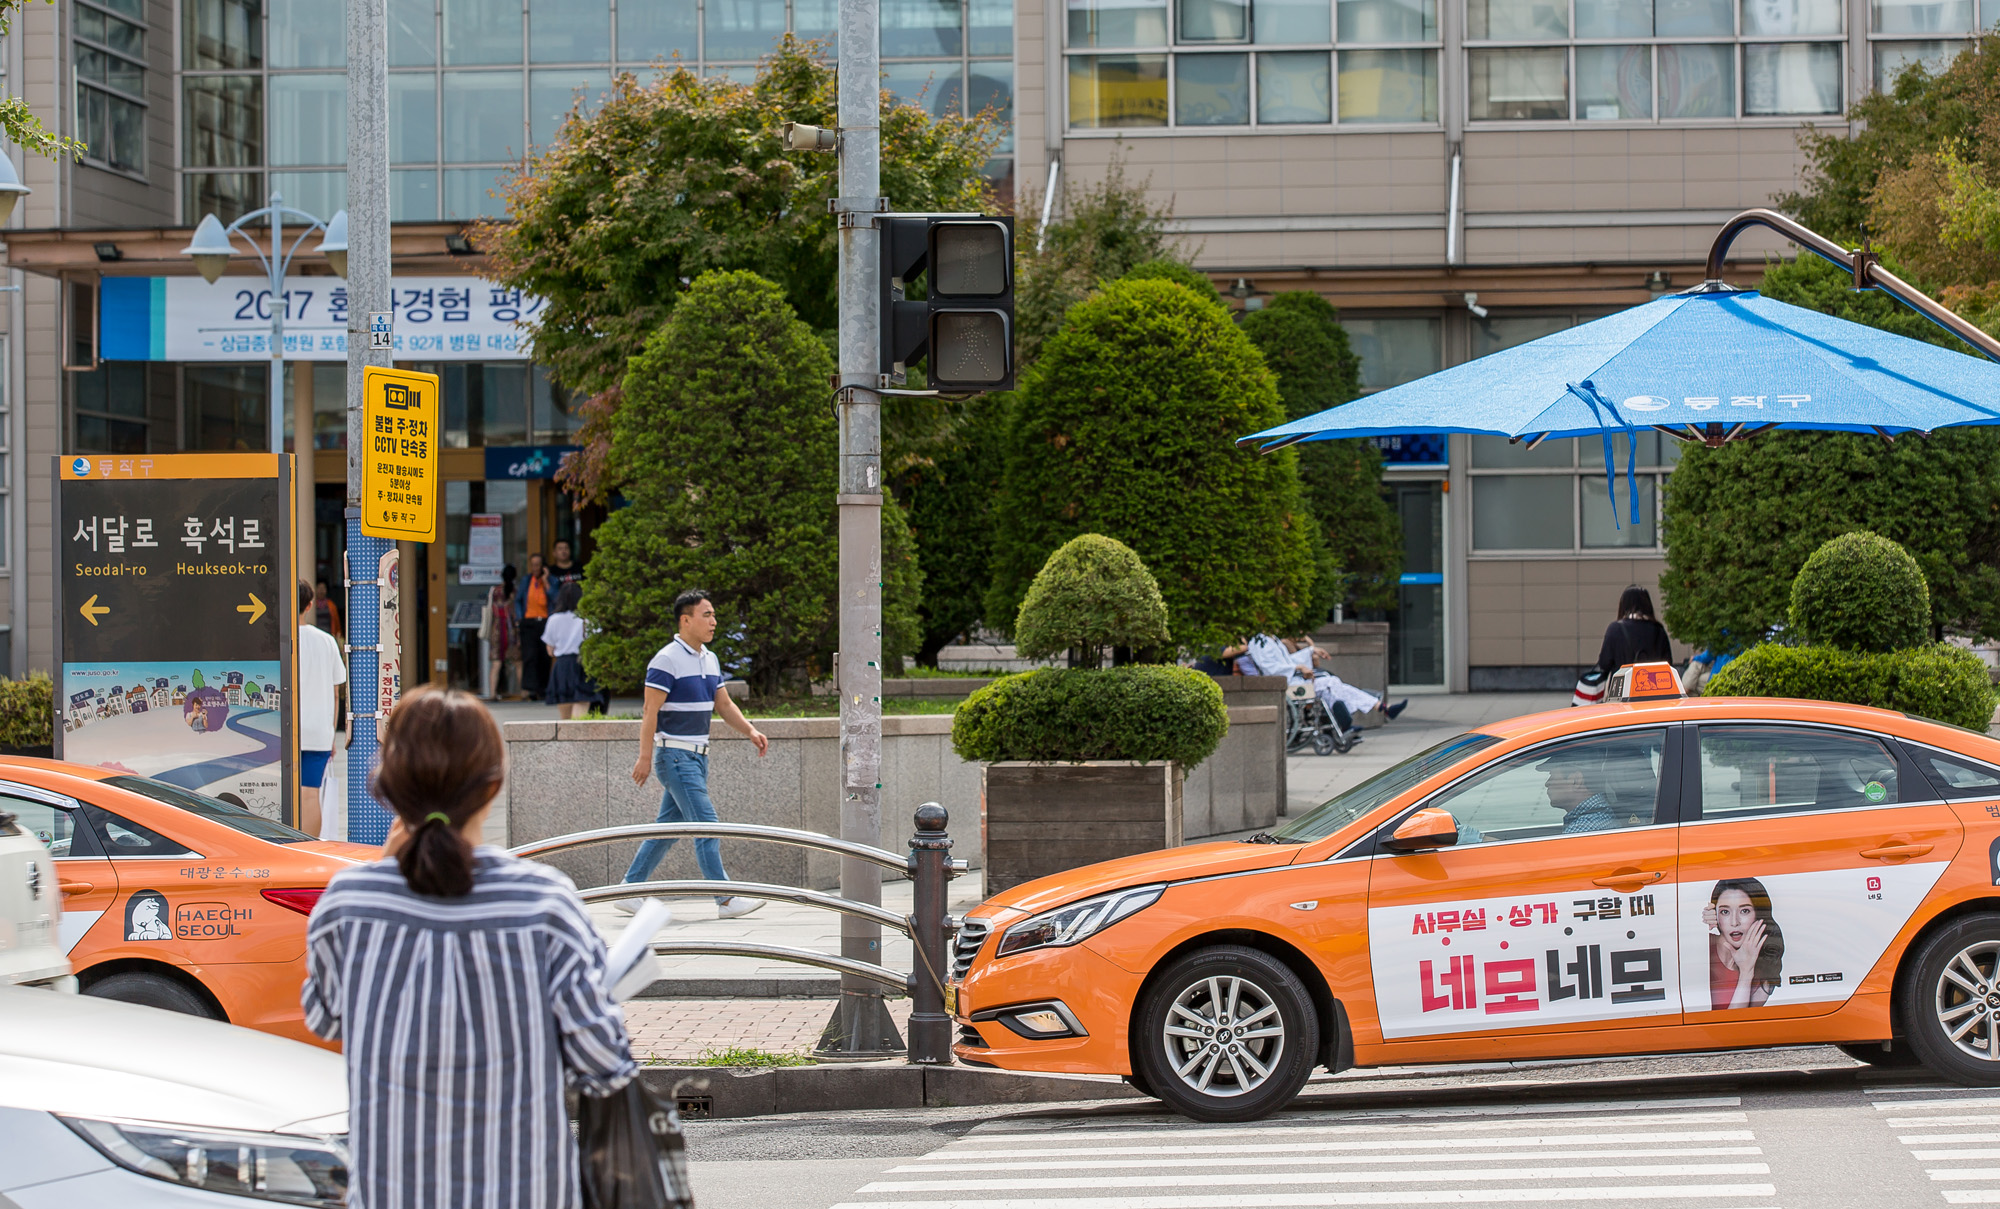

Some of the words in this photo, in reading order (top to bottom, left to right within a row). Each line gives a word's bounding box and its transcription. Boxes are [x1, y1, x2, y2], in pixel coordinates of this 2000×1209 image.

[234, 289, 314, 321] 2017
[373, 333, 390, 346] 14
[409, 335, 444, 352] 92개
[450, 335, 481, 352] 병원
[1684, 394, 1811, 411] 동작구
[375, 415, 393, 434] 불법
[375, 436, 397, 454] CCTV
[401, 439, 428, 459] 단속중
[99, 459, 153, 477] 동작구
[377, 463, 394, 475] 운전자
[390, 478, 410, 490] 5분이상
[391, 511, 416, 524] 동작구
[73, 515, 159, 553] 서달로
[180, 516, 265, 554] 흑석로
[75, 562, 147, 576] Seodal-ro
[177, 562, 268, 575] Heukseok-ro
[71, 669, 119, 677] www.juso.go.kr
[180, 866, 244, 879] 대광운수
[1867, 893, 1883, 901] 네모
[178, 909, 252, 922] HAECHI
[1412, 907, 1487, 935] 사무실
[1508, 902, 1558, 928] 상가
[1573, 897, 1622, 922] 구할
[1629, 894, 1655, 918] 때
[178, 924, 241, 937] SEOUL
[648, 1109, 682, 1135] GS
